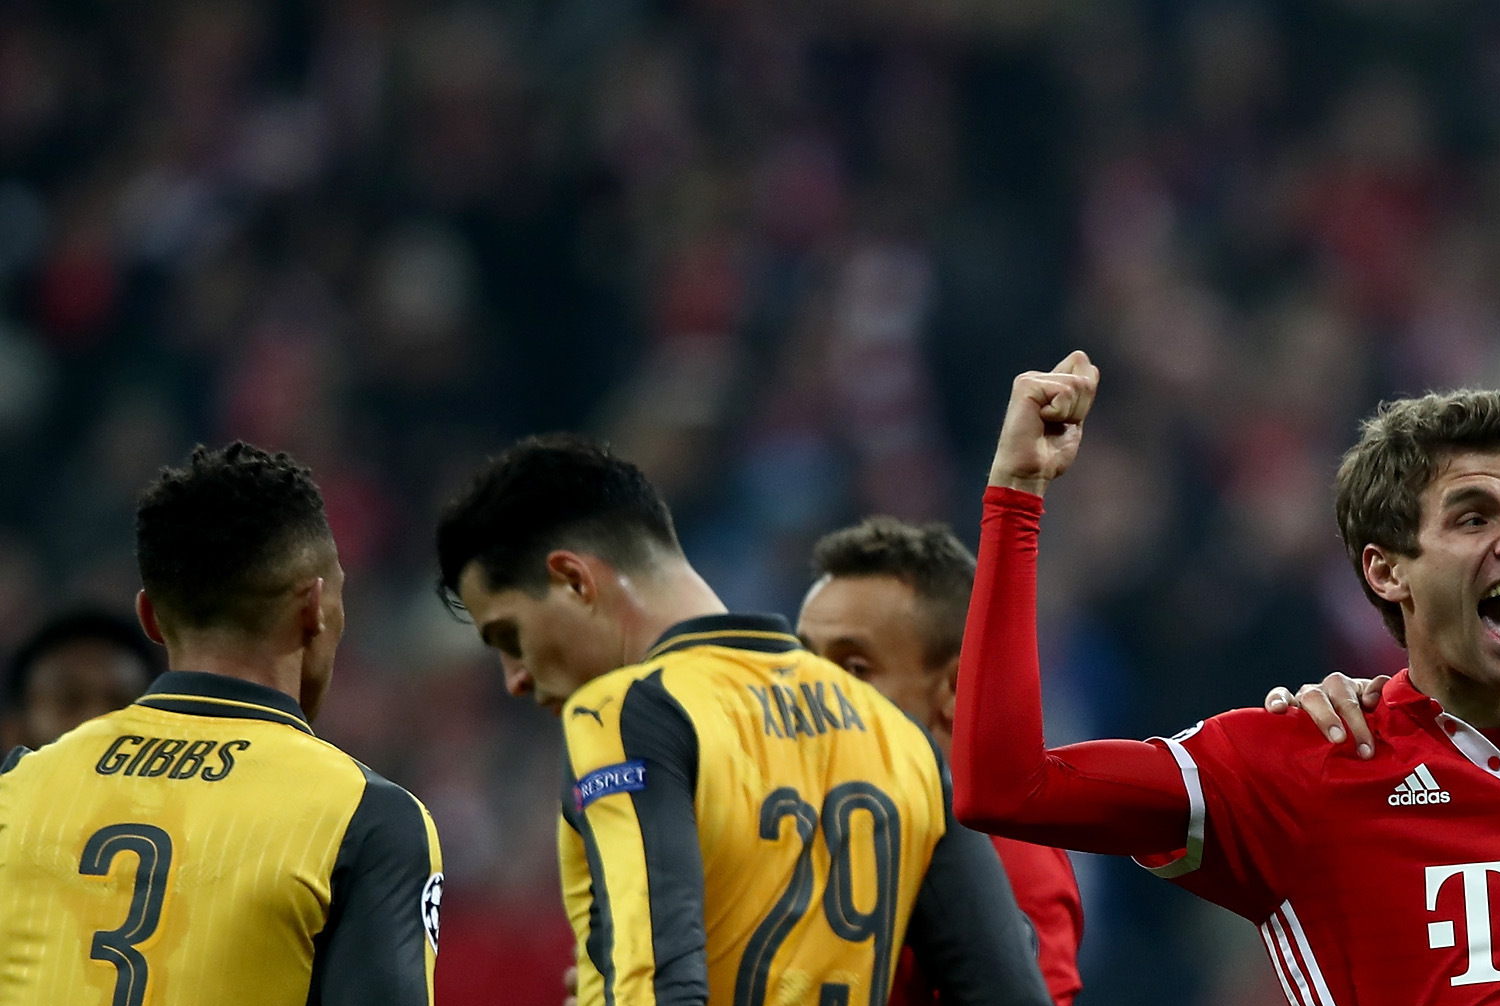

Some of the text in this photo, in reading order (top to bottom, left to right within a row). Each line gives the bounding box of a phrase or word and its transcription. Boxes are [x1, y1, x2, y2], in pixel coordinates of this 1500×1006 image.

[93, 735, 249, 782] GIBBS
[580, 766, 646, 798] RESPECT
[1388, 790, 1451, 806] adidas
